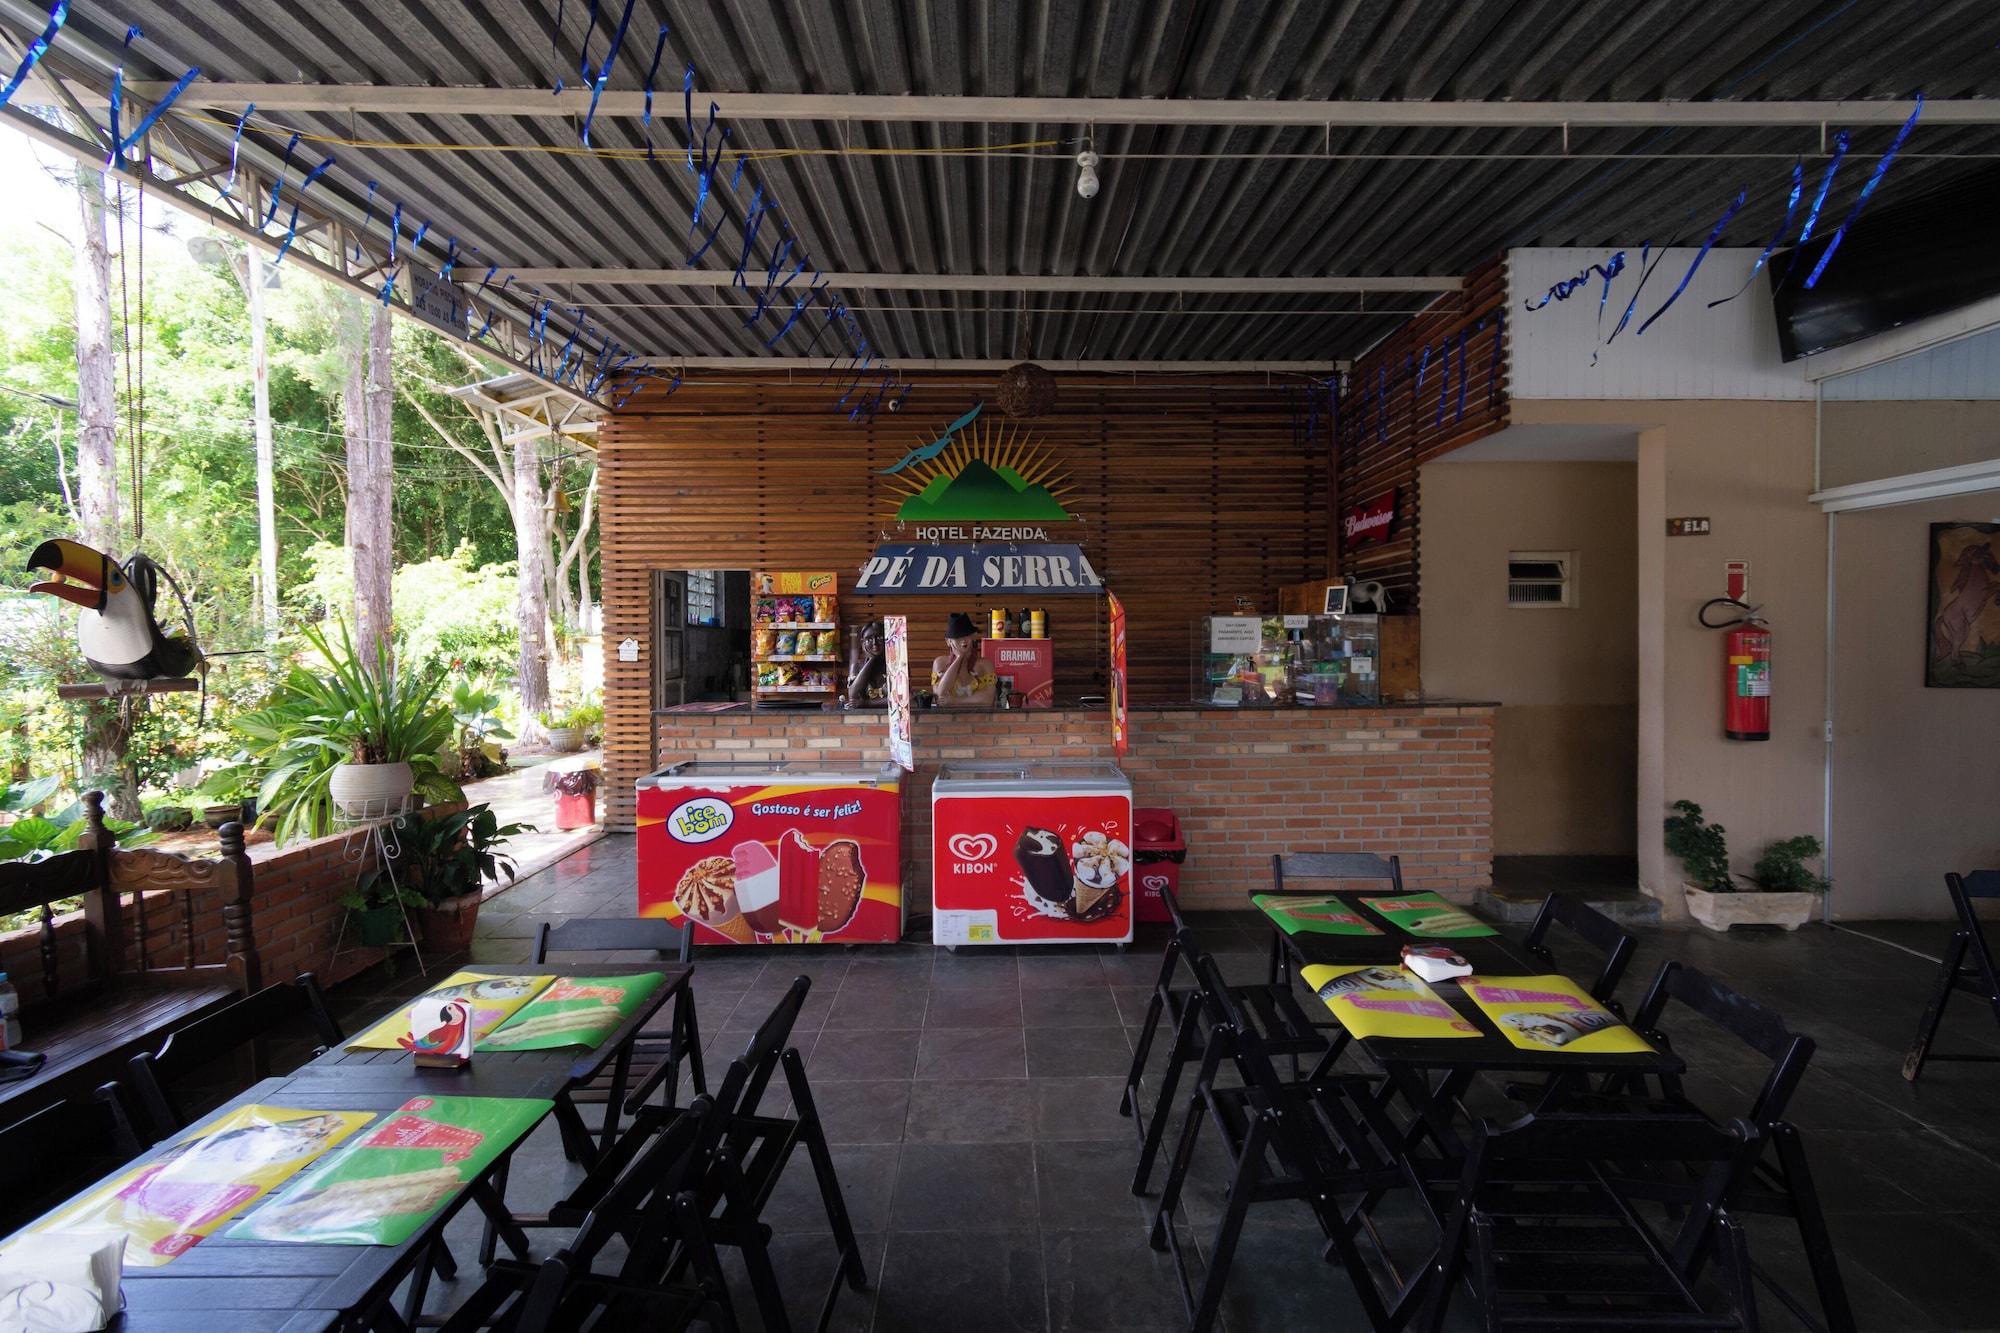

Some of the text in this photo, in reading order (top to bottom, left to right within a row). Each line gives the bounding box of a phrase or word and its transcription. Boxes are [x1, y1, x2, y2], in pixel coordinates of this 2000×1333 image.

[1345, 509, 1394, 538] Budweiser
[1683, 520, 1709, 532] ELA
[916, 526, 1045, 541] HOTEL FAZENDA
[855, 546, 1103, 588] PÉ DA SERRA
[1000, 650, 1036, 662] BRAHMA
[686, 805, 716, 823] ice
[751, 799, 862, 820] Gostoso é ser feliz!
[676, 813, 728, 837] bom
[953, 862, 993, 874] KIBON
